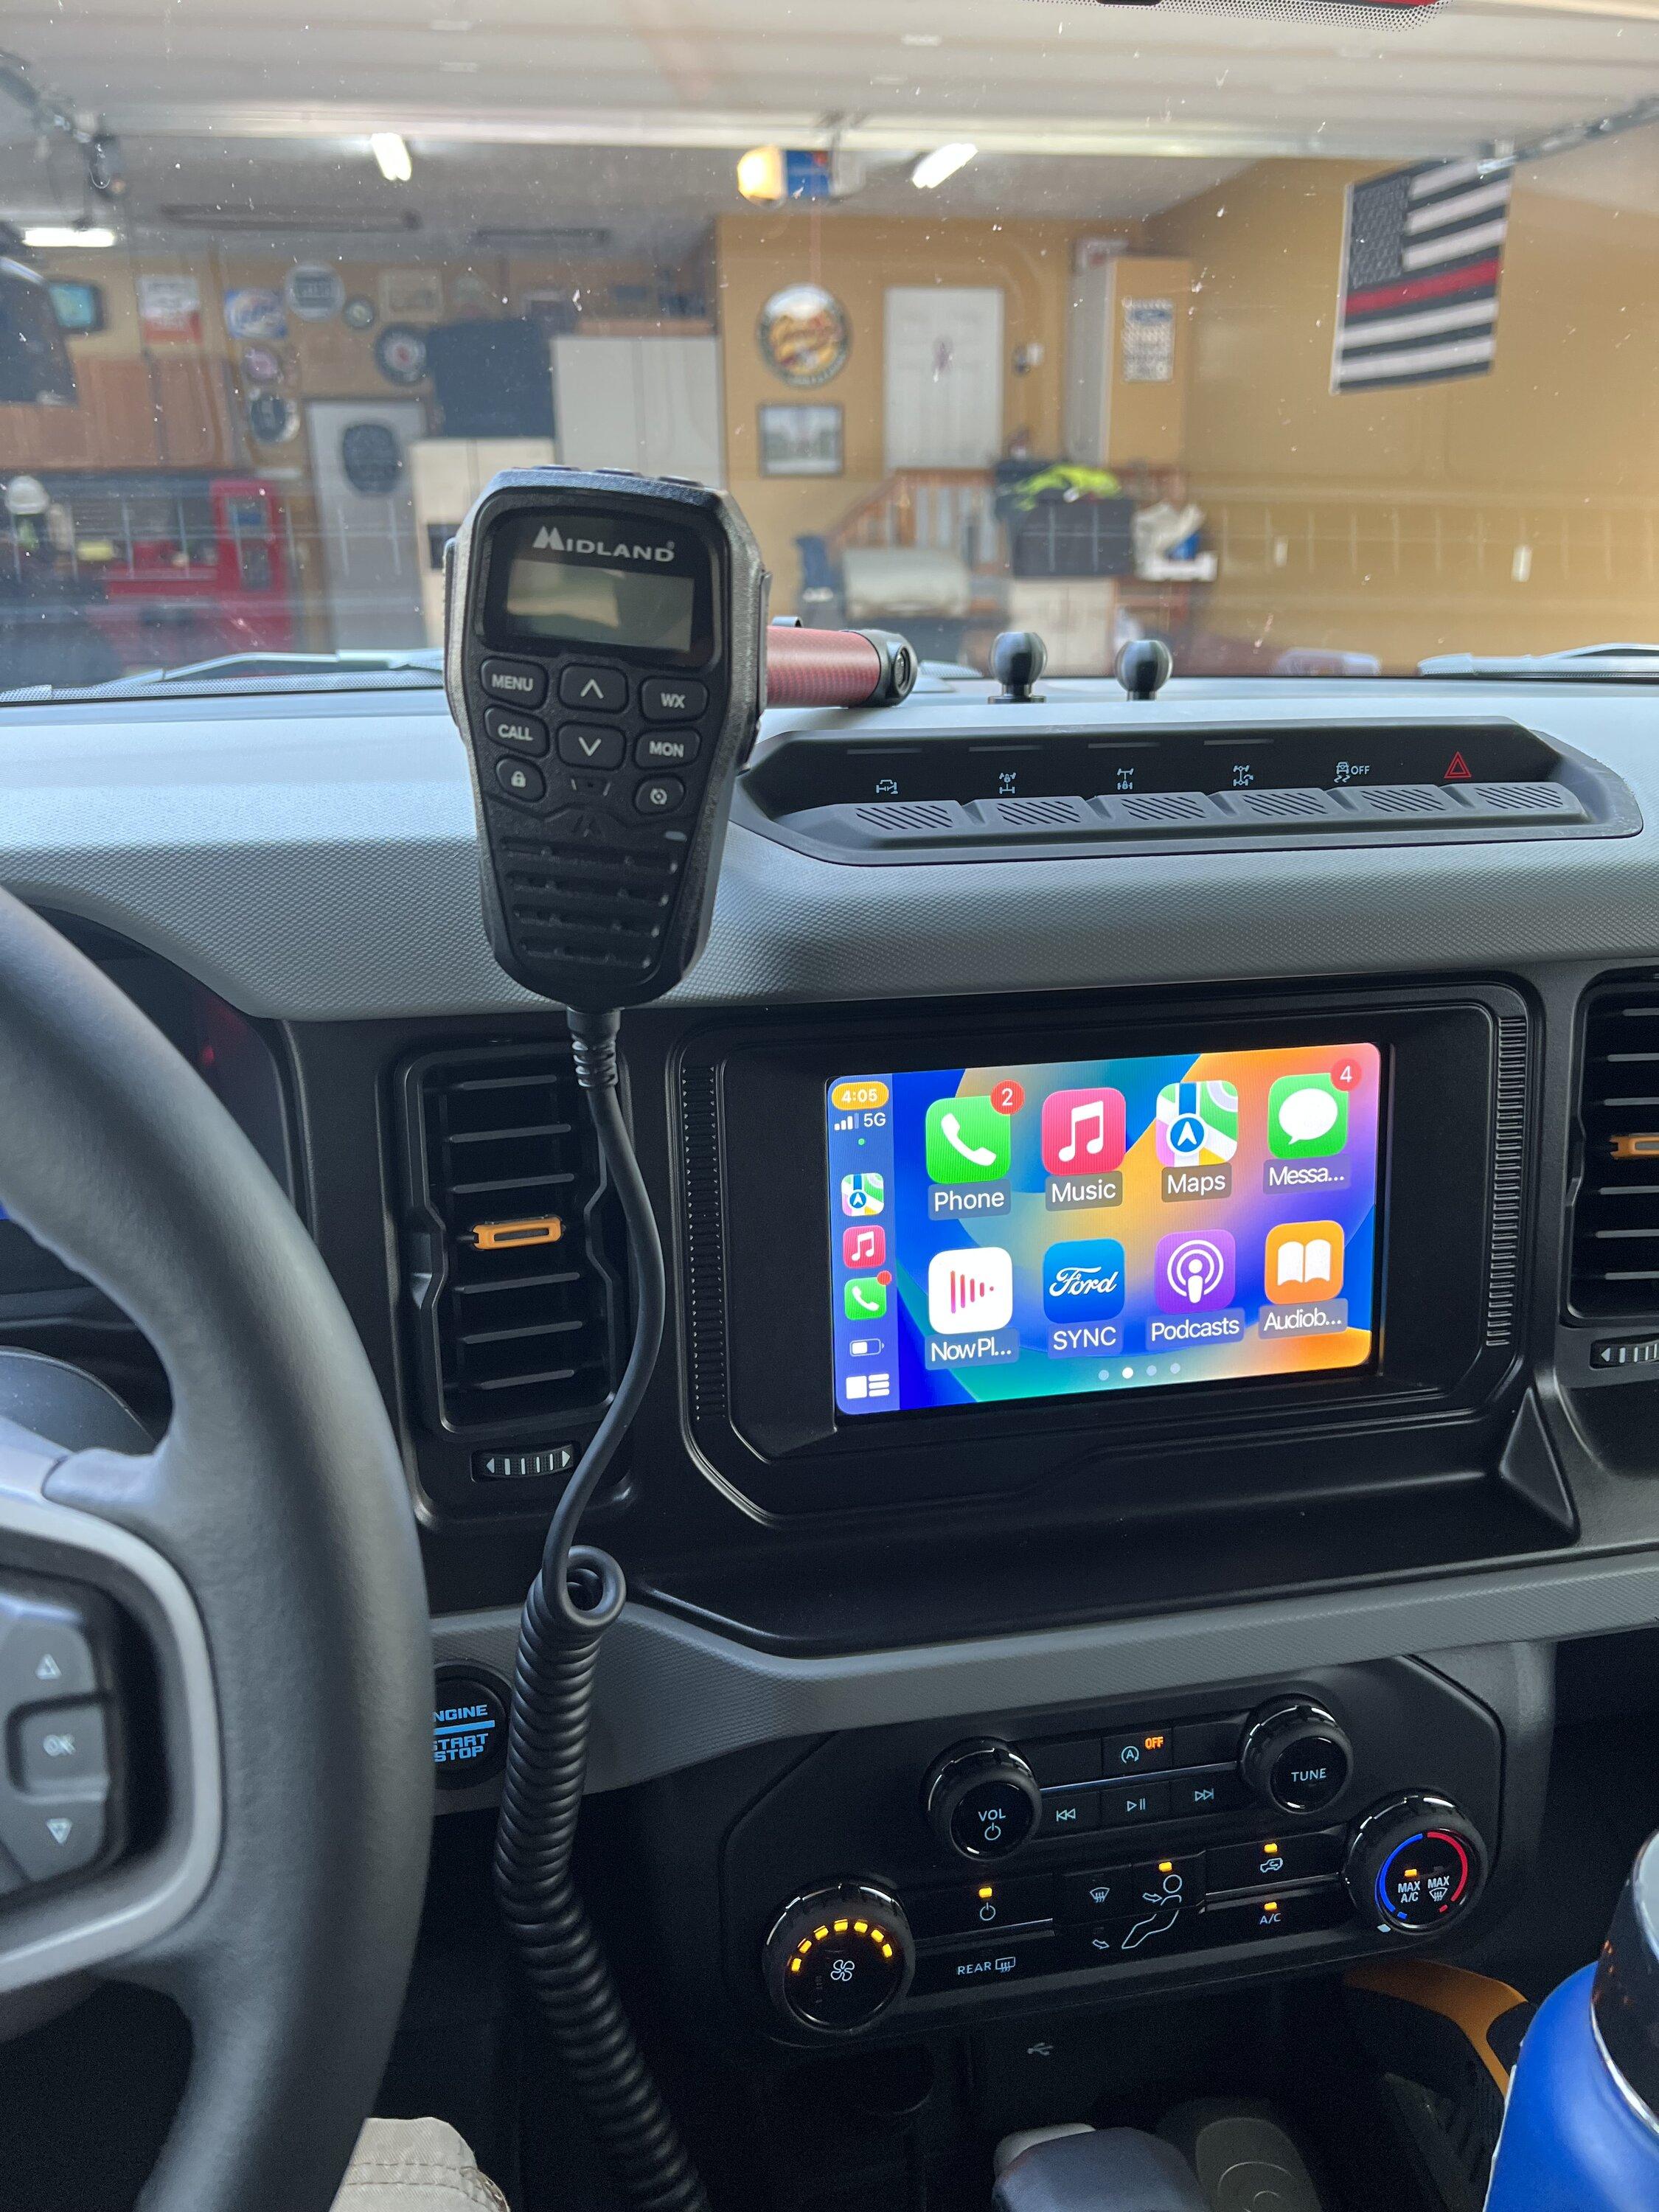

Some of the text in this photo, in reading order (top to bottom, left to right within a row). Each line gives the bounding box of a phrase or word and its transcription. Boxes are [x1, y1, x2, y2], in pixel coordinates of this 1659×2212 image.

[492, 672, 533, 693] MENU
[661, 692, 686, 709] WX
[498, 724, 533, 742] CALL
[649, 741, 684, 758] MON
[1351, 765, 1370, 775] OFF
[1339, 1065, 1353, 1083] 4
[841, 1088, 878, 1103] 4:05
[1001, 1088, 1014, 1107] 2
[863, 1113, 886, 1128] 5G
[1051, 1179, 1116, 1203] Music
[1167, 1172, 1226, 1198] Maps
[934, 1190, 1005, 1213] Phone
[1049, 1266, 1119, 1297] Ford
[1151, 1317, 1240, 1342] Podcasts
[1053, 1326, 1116, 1351] SYNC
[432, 1704, 488, 1722] NGINE
[43, 1733, 76, 1756] OK
[1144, 1736, 1164, 1750] OFF
[433, 1745, 484, 1763] STOP
[1291, 1767, 1327, 1783] TUNE
[978, 1809, 1006, 1821] VOL
[1397, 1880, 1421, 1893] MAX
[1427, 1875, 1450, 1889] MAX
[1400, 1891, 1419, 1903] A/C
[1259, 1913, 1281, 1925] A/C
[957, 1961, 992, 1975] REAR
